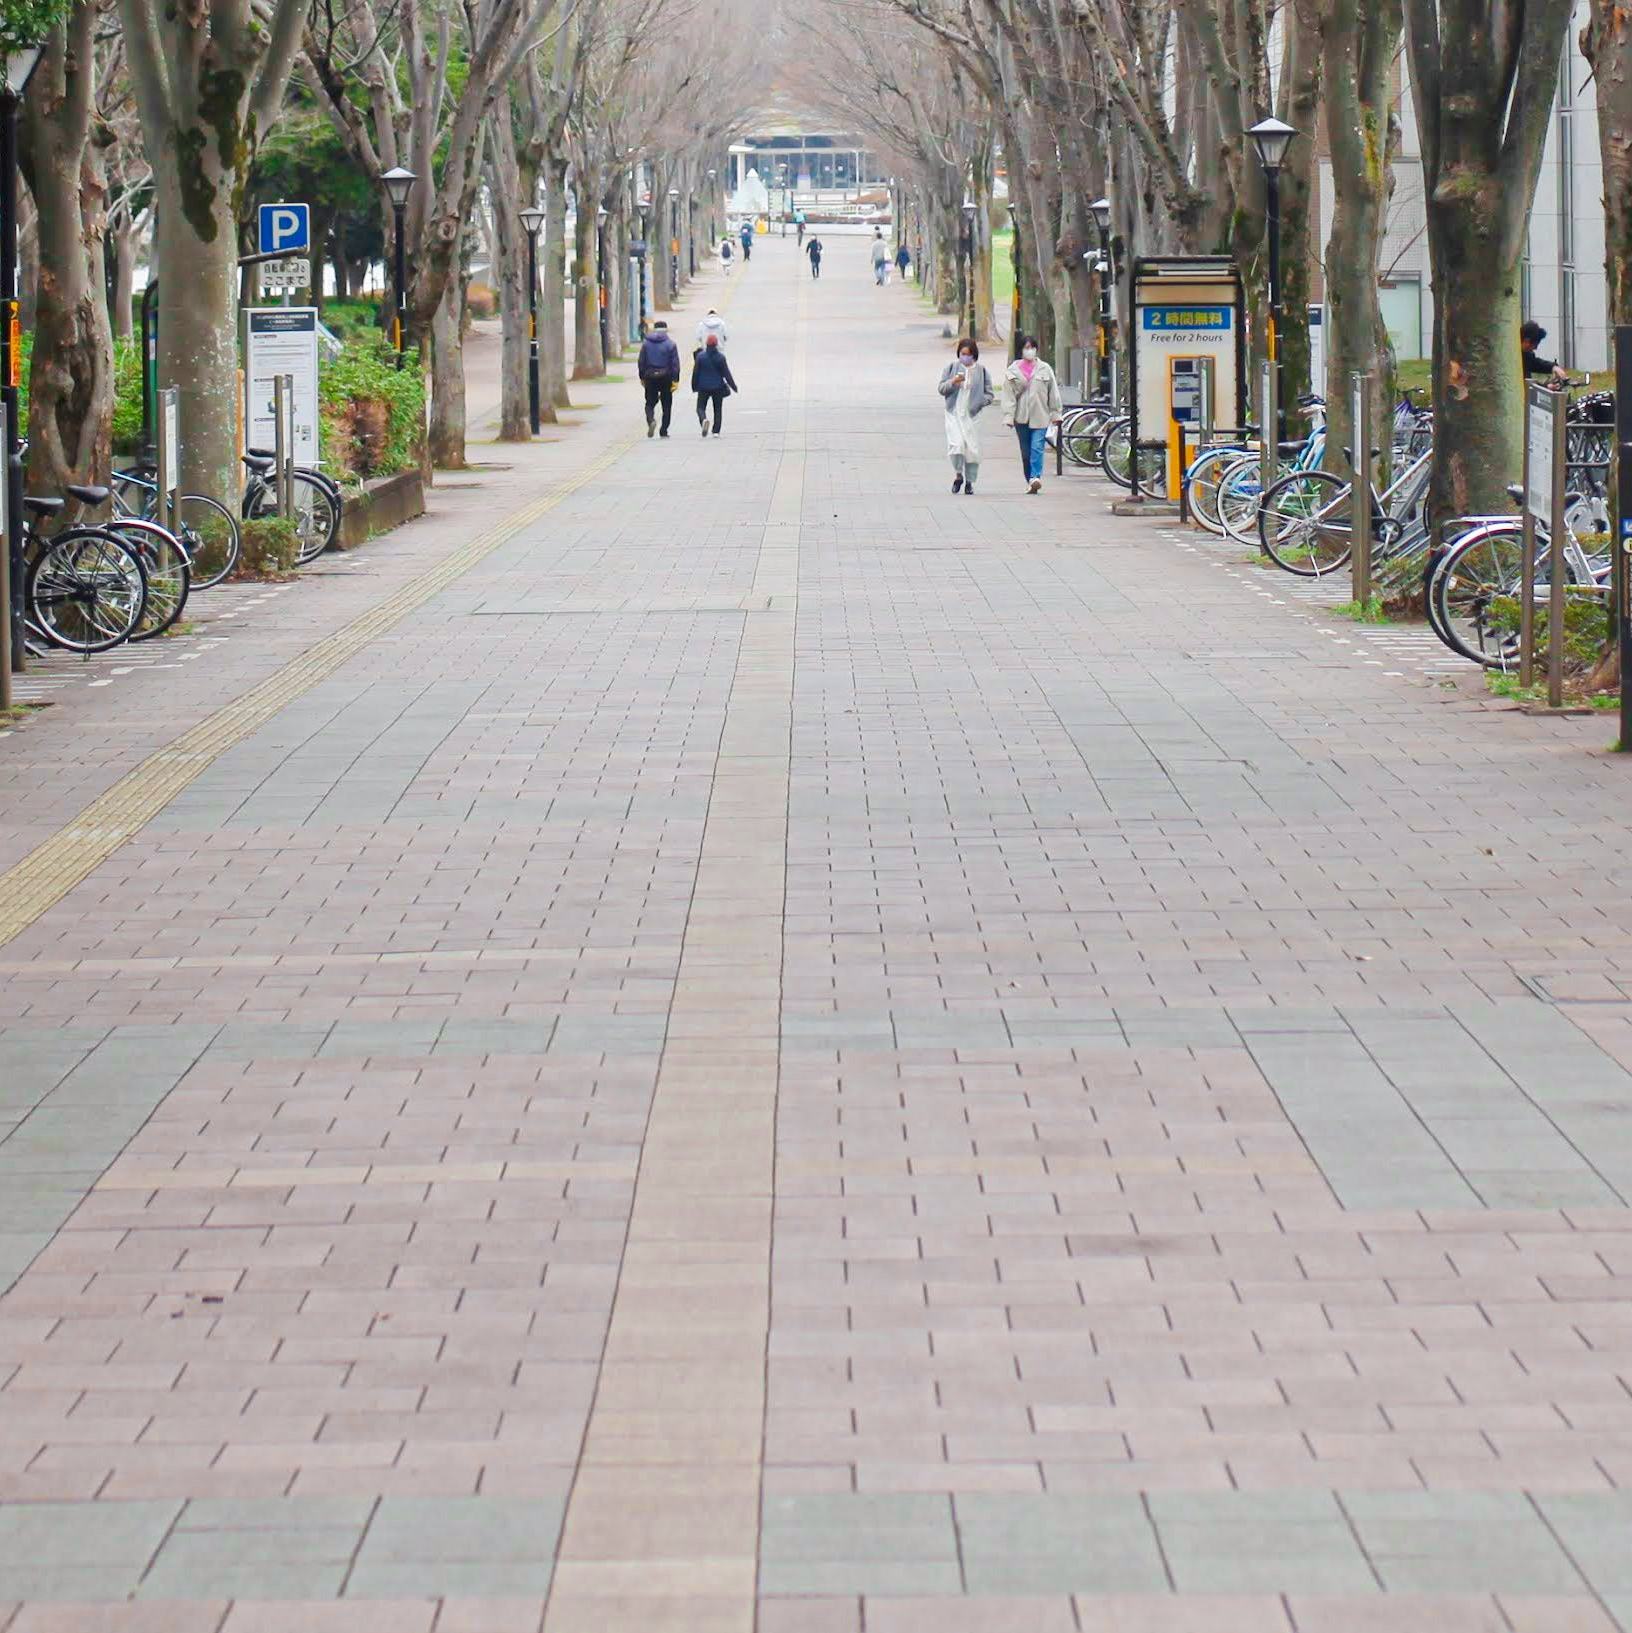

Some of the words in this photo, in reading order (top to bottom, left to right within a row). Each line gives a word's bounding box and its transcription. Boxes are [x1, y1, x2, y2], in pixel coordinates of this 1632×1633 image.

[272, 210, 300, 249] P
[264, 276, 307, 286] ここまで
[1151, 312, 1162, 325] 2
[1165, 311, 1223, 326] 時間無料
[1150, 333, 1171, 342] Free
[1172, 333, 1187, 343] for
[1188, 333, 1195, 342] 2
[1196, 333, 1223, 342] hours
